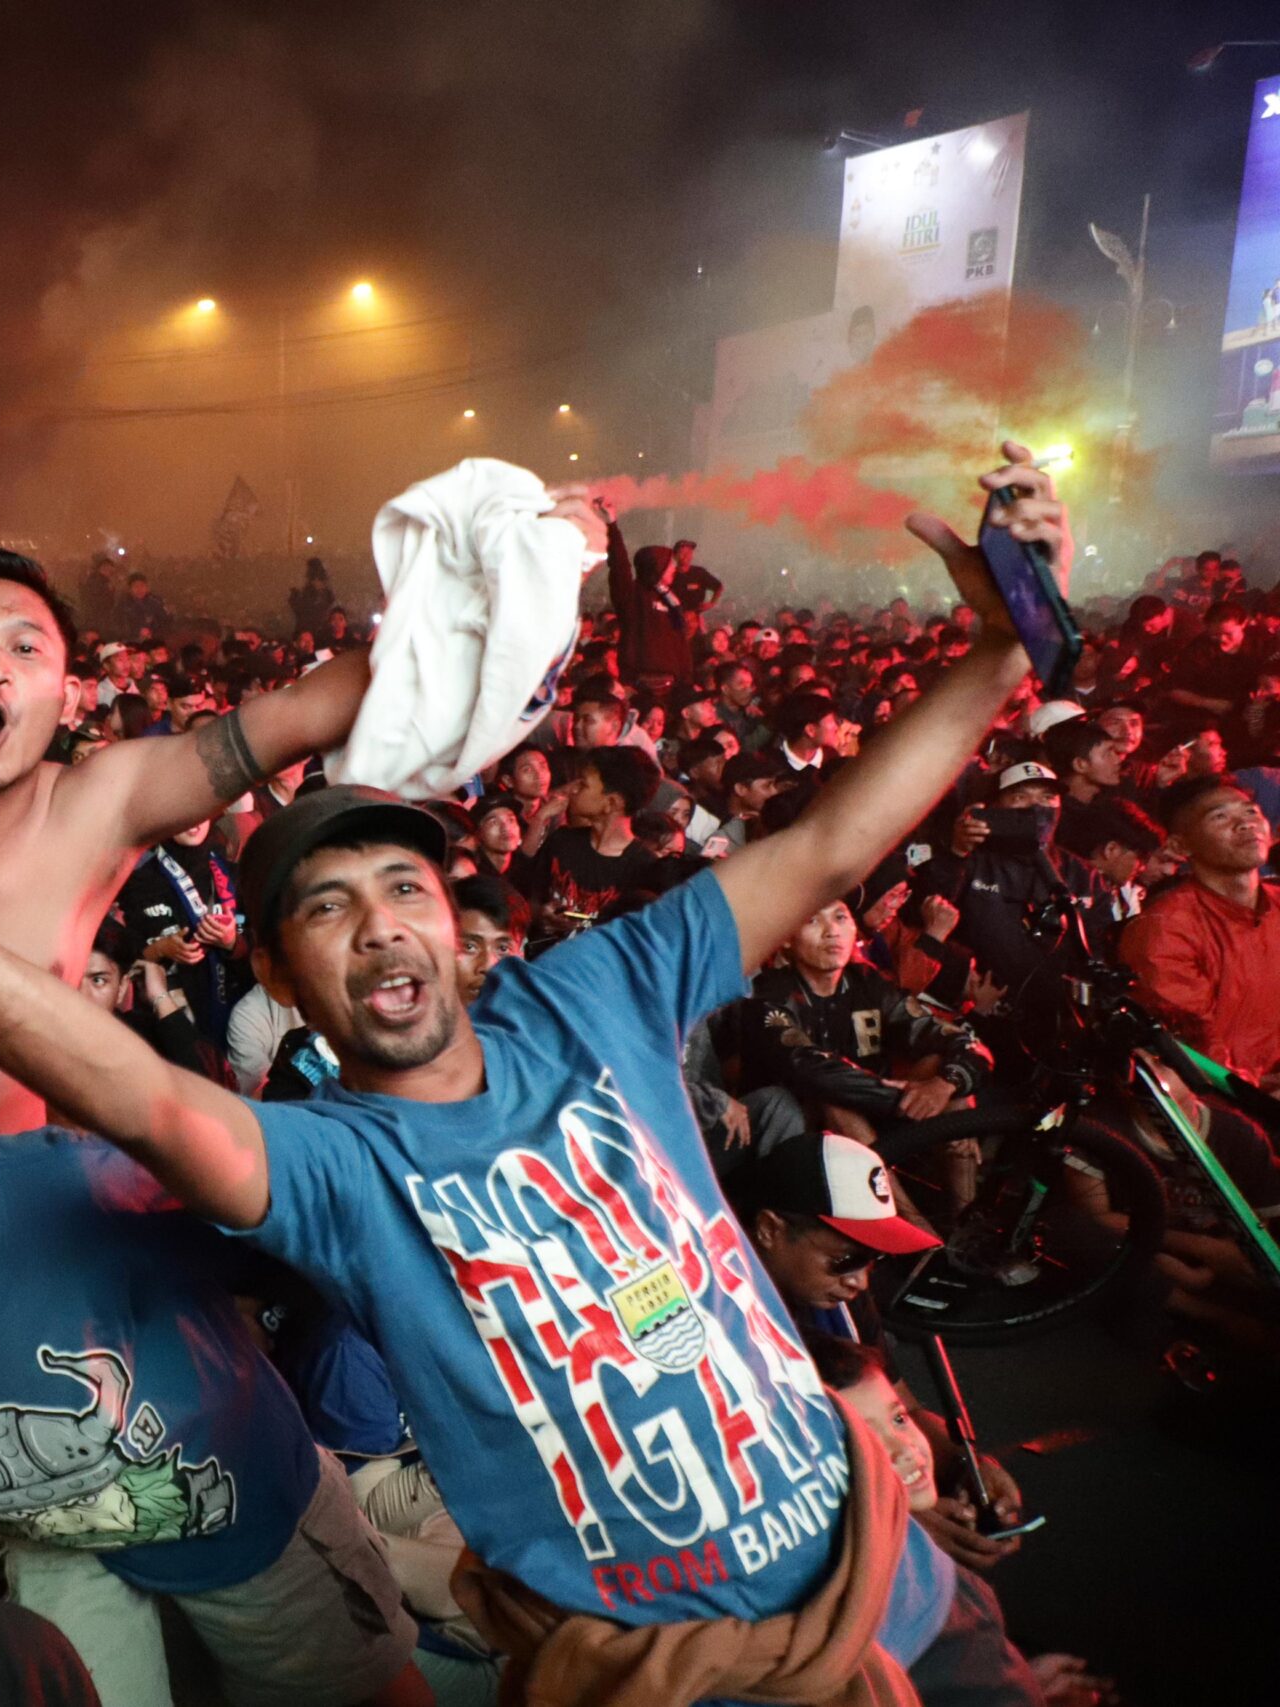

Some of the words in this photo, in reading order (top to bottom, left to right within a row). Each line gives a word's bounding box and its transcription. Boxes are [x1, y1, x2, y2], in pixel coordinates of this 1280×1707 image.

[906, 211, 939, 230] IDUL
[902, 227, 940, 247] FITRI
[966, 265, 995, 279] PKB
[625, 1272, 671, 1306] PERSIB
[592, 1539, 729, 1610] FROM
